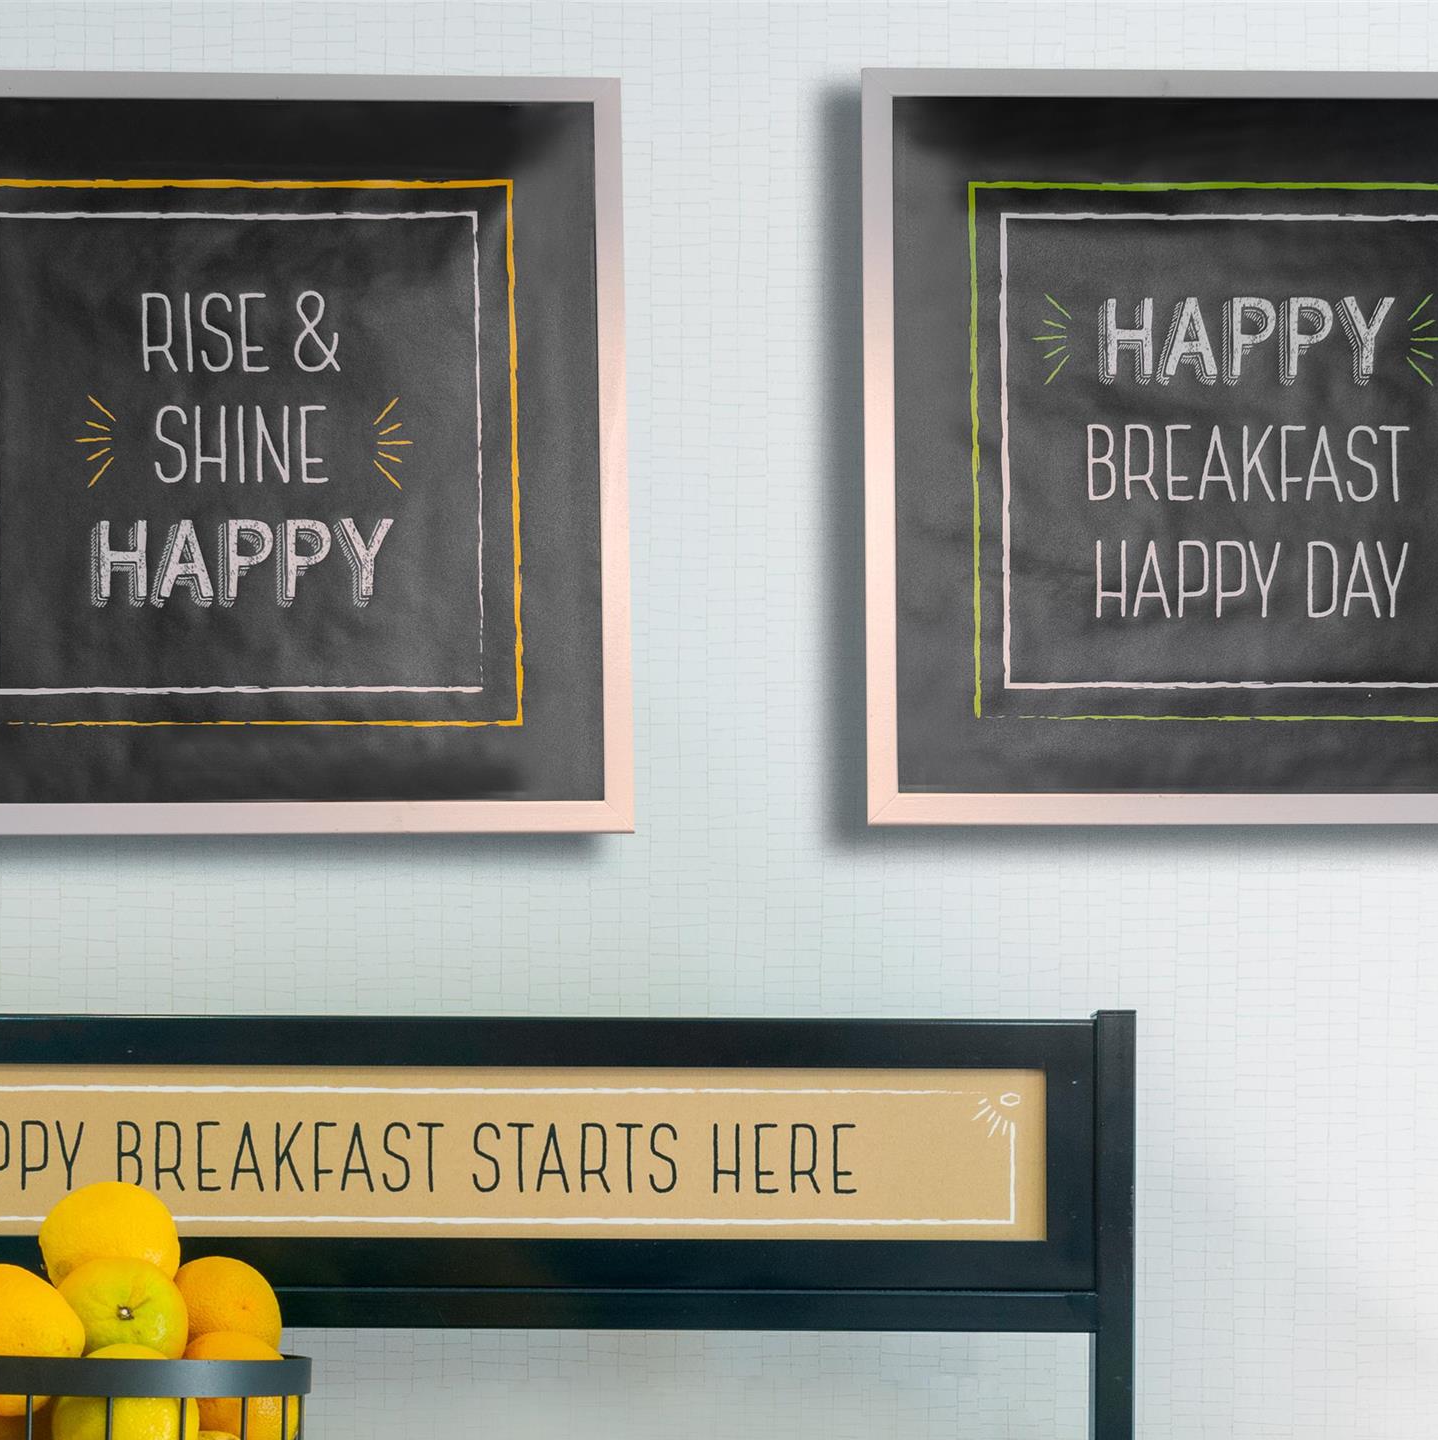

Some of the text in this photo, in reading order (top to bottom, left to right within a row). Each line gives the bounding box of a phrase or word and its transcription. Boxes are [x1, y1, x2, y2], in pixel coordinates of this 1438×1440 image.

[142, 290, 342, 374] RISE &
[1097, 296, 1397, 386] HAPPY
[154, 404, 330, 485] SHINE
[1086, 423, 1411, 504] BREAKFAST
[91, 518, 396, 608] HAPPY
[1095, 539, 1410, 619] HAPPY DAY
[117, 1120, 445, 1194] BREAKFAST
[473, 1122, 680, 1195] STARTS
[714, 1124, 859, 1195] HERE
